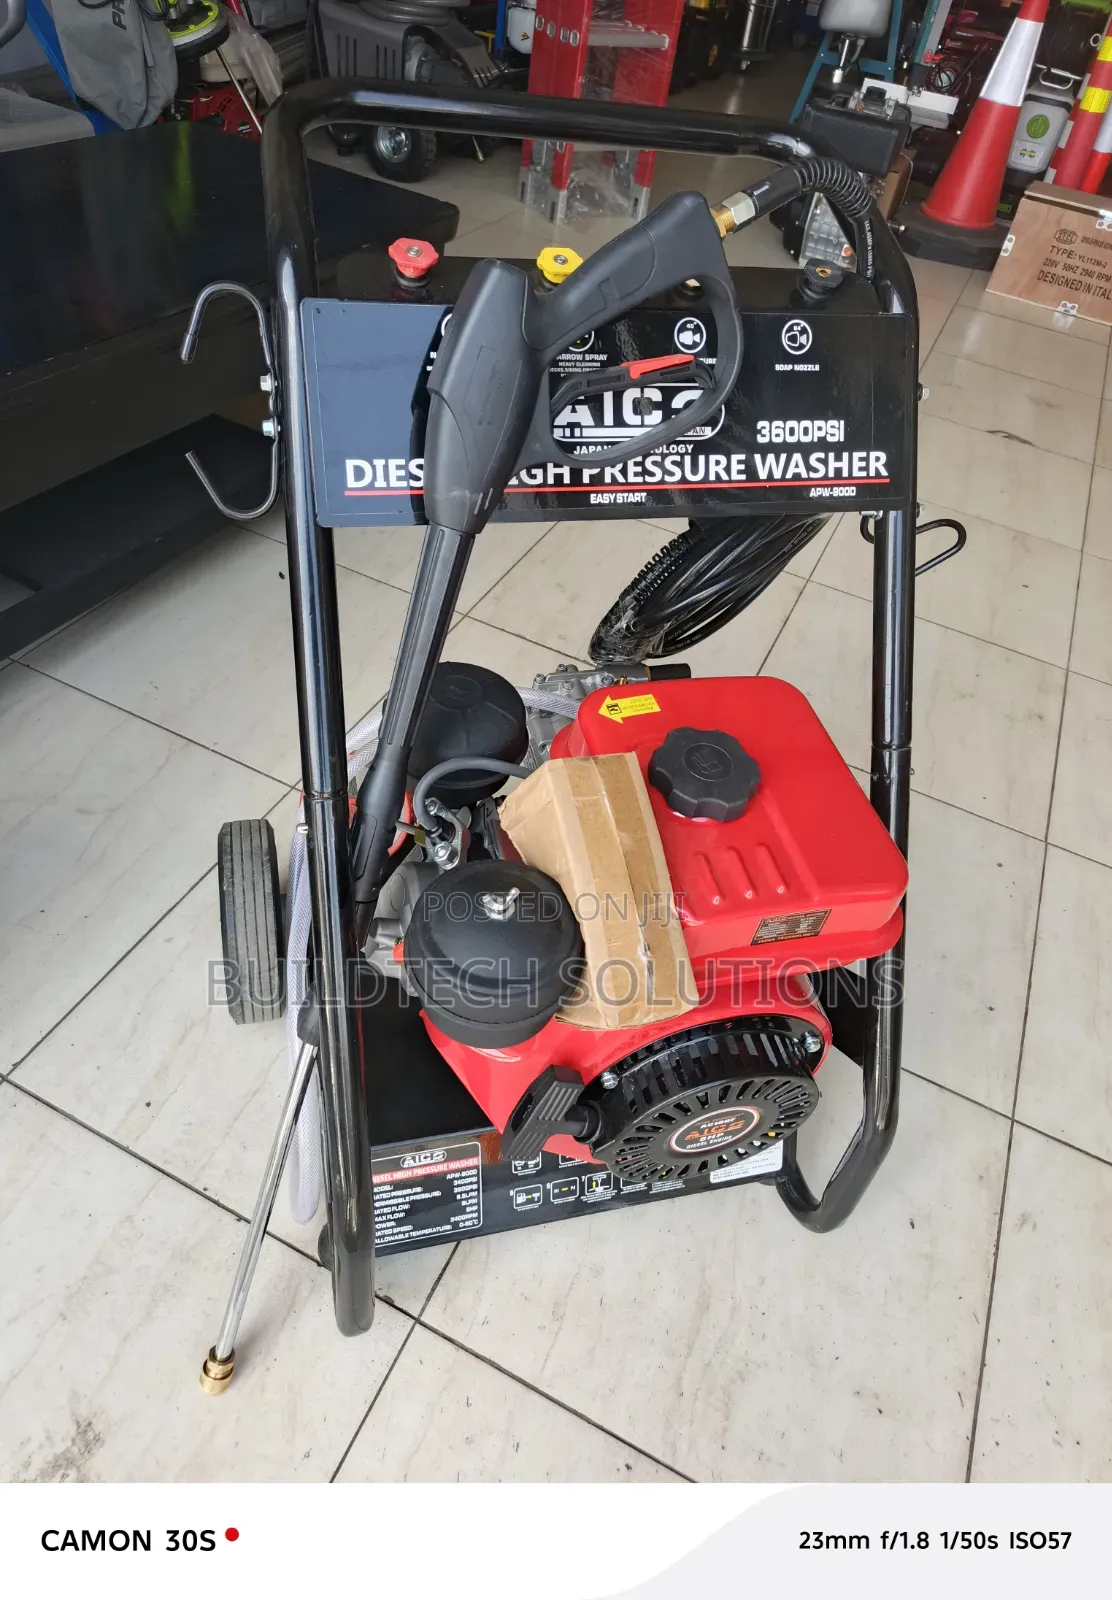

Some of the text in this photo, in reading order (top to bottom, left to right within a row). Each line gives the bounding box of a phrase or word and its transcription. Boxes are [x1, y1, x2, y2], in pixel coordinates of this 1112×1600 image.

[1050, 245, 1077, 260] TYPE:
[1043, 258, 1112, 284] 220V 50HZ 2940 RPM
[1037, 270, 1112, 300] DESIGNED IN ITAL
[557, 353, 608, 361] ARROW SPRAY
[757, 420, 845, 443] 3600PSI
[345, 458, 425, 489] DIES
[582, 454, 747, 484] PRESSURE
[753, 451, 889, 480] WASHER
[590, 492, 647, 504] EASY START
[393, 1170, 412, 1181] HIGH
[413, 1164, 448, 1175] PRESSURE
[448, 1158, 479, 1169] WASHER
[391, 1186, 424, 1197] PRESSURE:
[409, 1190, 442, 1201] PRESSURE:
[375, 1220, 397, 1229] OWER:
[392, 1224, 414, 1234] SPEED:
[374, 1232, 410, 1244] ALLOWABLE
[409, 1224, 453, 1237] TEMPERATURE:
